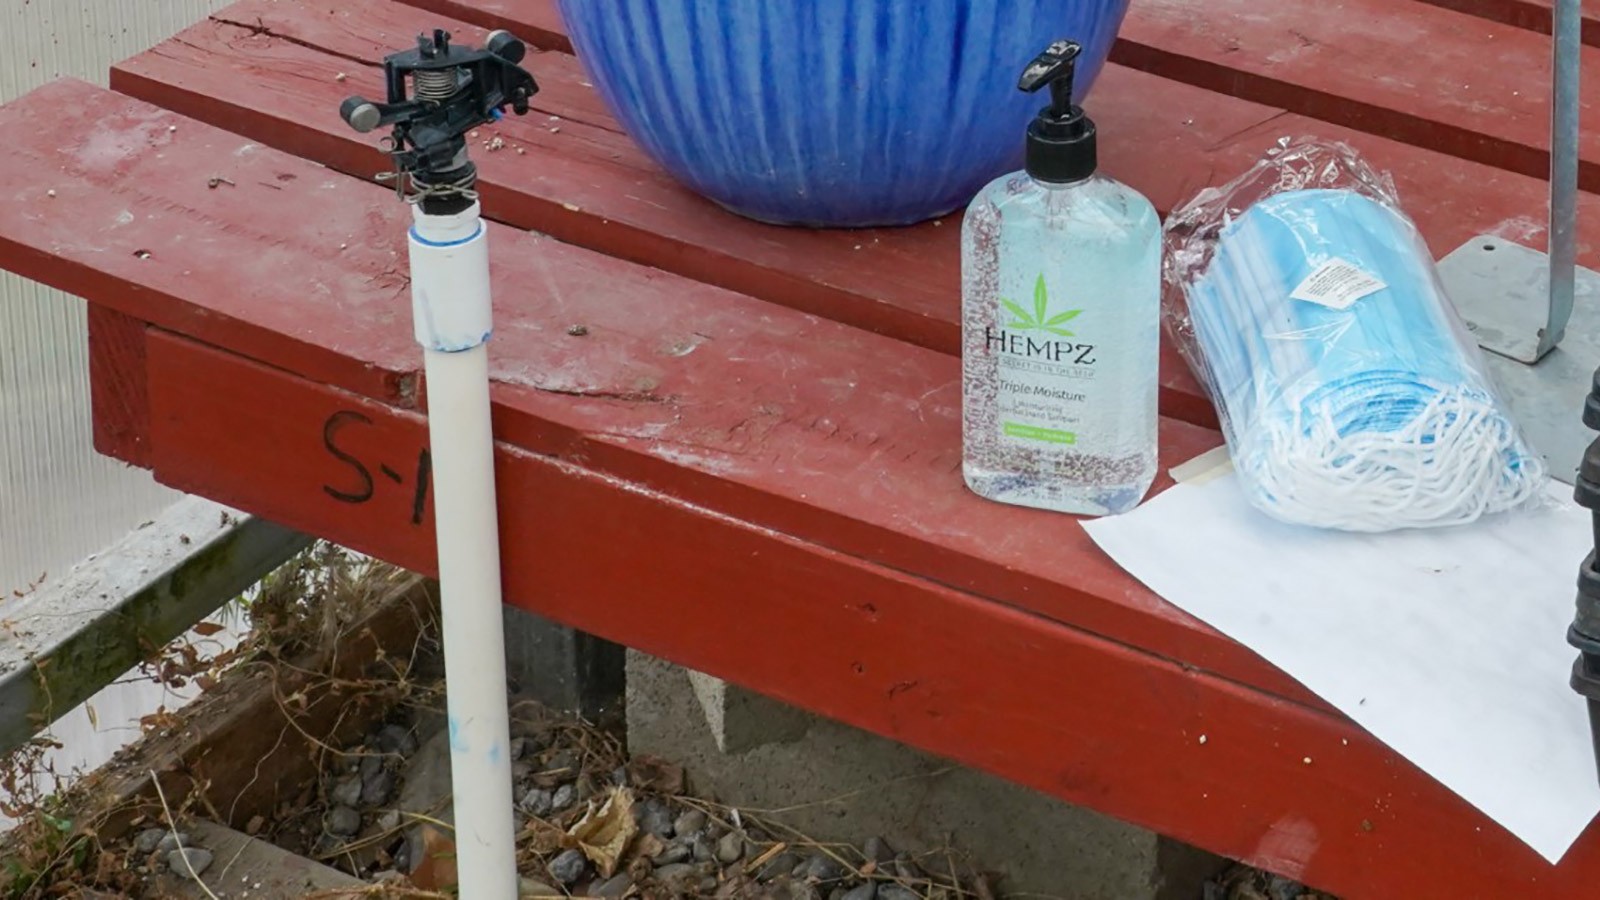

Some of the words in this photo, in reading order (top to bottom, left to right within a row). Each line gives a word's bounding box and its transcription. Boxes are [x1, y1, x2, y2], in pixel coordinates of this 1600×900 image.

[986, 326, 1096, 365] HEMPZ
[999, 379, 1032, 394] Triple
[1033, 385, 1086, 402] Moisture
[323, 409, 431, 525] S-1
